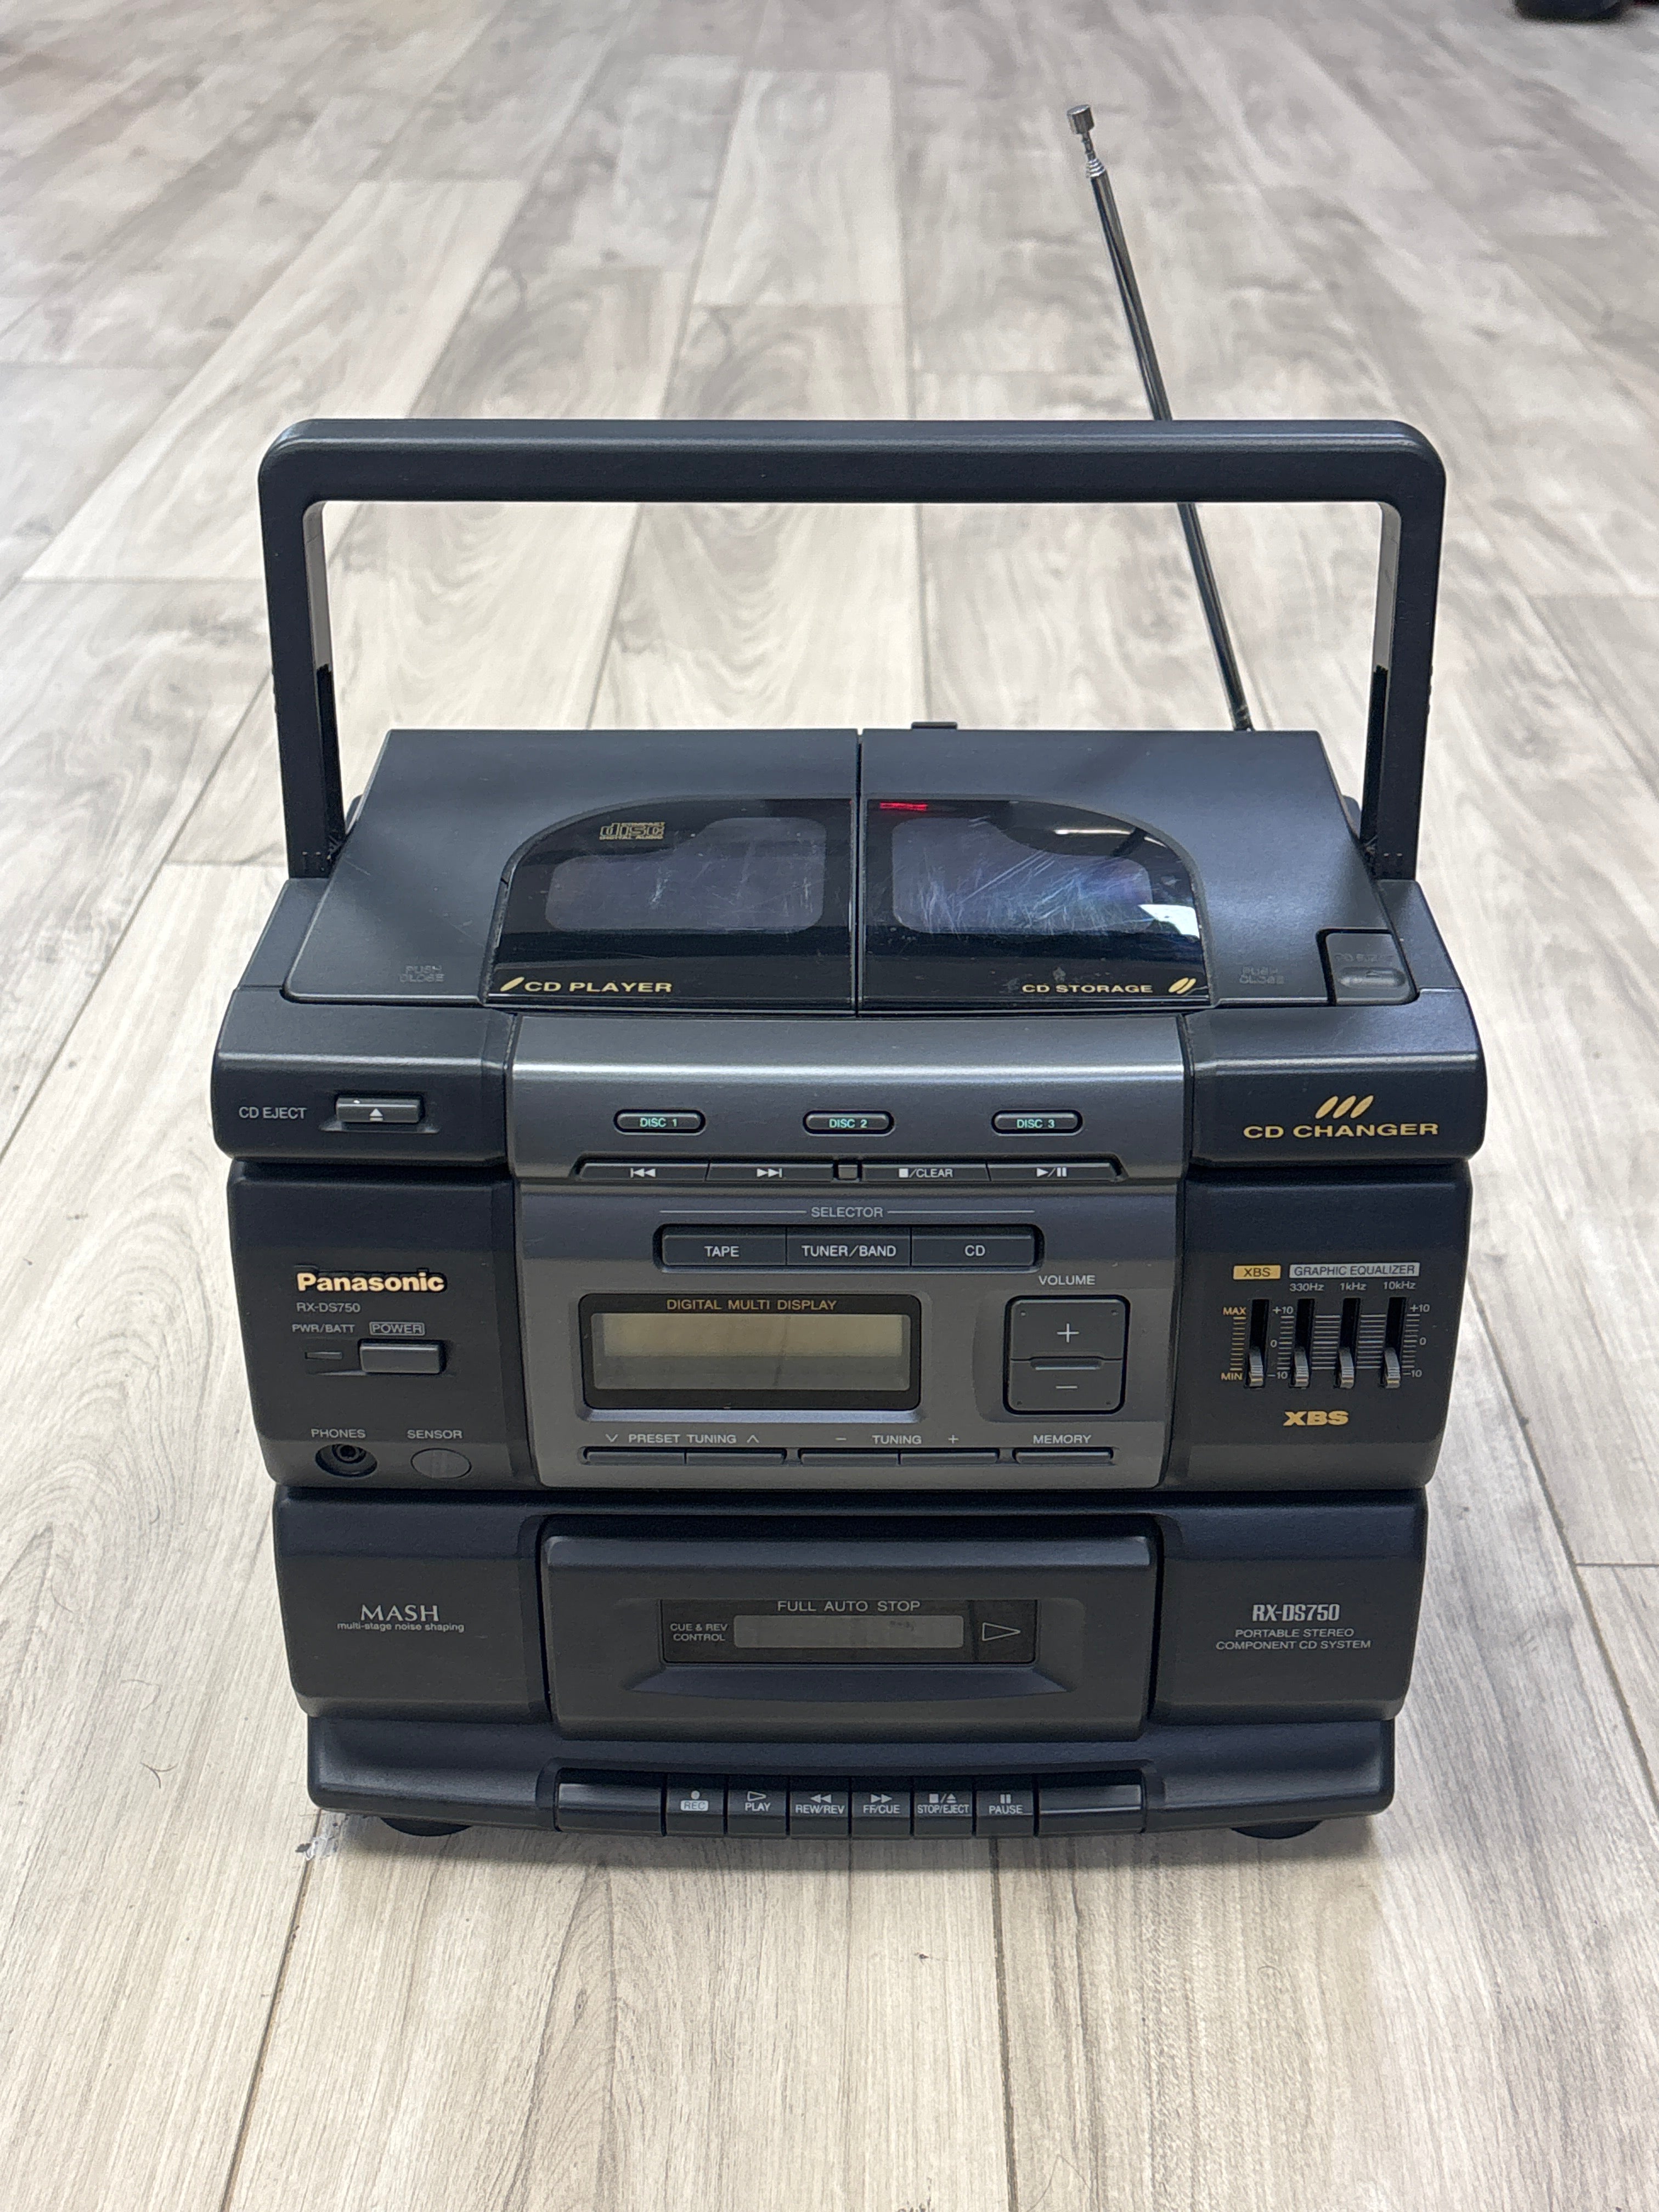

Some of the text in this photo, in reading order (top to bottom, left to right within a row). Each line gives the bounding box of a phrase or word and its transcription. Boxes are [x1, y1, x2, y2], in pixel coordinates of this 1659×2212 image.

[524, 981, 672, 993] CD PLAYER
[1022, 984, 1153, 994] CD STORAGE
[238, 1106, 307, 1119] CD EJECT
[640, 1118, 677, 1128] DISC 1
[829, 1119, 867, 1128] DISC 2
[1017, 1119, 1055, 1128] DISC 3
[1243, 1123, 1438, 1139] CD CHANGER
[811, 1207, 884, 1218] SELECTOR
[704, 1245, 740, 1257] TAPE
[801, 1245, 896, 1257] TUNER/BAND
[964, 1245, 985, 1257] CD
[1243, 1267, 1271, 1278] XBS
[1293, 1264, 1415, 1277] GRAPHIC EQUALIZER
[296, 1272, 445, 1293] Panasonic
[1039, 1274, 1096, 1285] VOLUME
[1289, 1283, 1325, 1292] 330Hz
[1340, 1283, 1367, 1292] 1kHz
[1383, 1281, 1417, 1290] 10kHz
[296, 1302, 362, 1313] RX-DS750
[667, 1299, 837, 1311] DIGITAL MULTI DISPLAY
[1409, 1304, 1430, 1313] +10
[1222, 1307, 1246, 1316] MAX
[1272, 1306, 1294, 1315] +10
[291, 1324, 356, 1334] PWR/BATT
[372, 1324, 422, 1334] POWER
[1270, 1340, 1277, 1348] 0
[1419, 1337, 1426, 1346] 0
[1221, 1372, 1243, 1381] MIN
[1283, 1411, 1349, 1426] XBS
[311, 1429, 366, 1439] PHONES
[407, 1430, 463, 1440] SENSOR
[628, 1434, 737, 1444] PRESET TUNING
[872, 1435, 922, 1444] TUNING
[1033, 1435, 1091, 1444] MEMORY
[777, 1601, 921, 1612] FULL AUTO STOP
[360, 1605, 439, 1622] MASH
[1252, 1604, 1340, 1622] RX-DS750
[337, 1622, 465, 1633] multi-stage noise shaping
[696, 1623, 702, 1632] &
[706, 1623, 728, 1632] REV
[673, 1633, 725, 1641] CONTROL
[1235, 1628, 1355, 1638] PORTABLE STEREO
[1216, 1640, 1372, 1650] COMPONENT CD SYSTEM
[684, 1802, 706, 1810] REC
[745, 1803, 770, 1811] PLAY
[795, 1804, 844, 1814] REW/REV
[863, 1804, 900, 1814] FF/CUE
[917, 1804, 969, 1814] STOP/EJECT
[989, 1804, 1023, 1814] PAUSE
